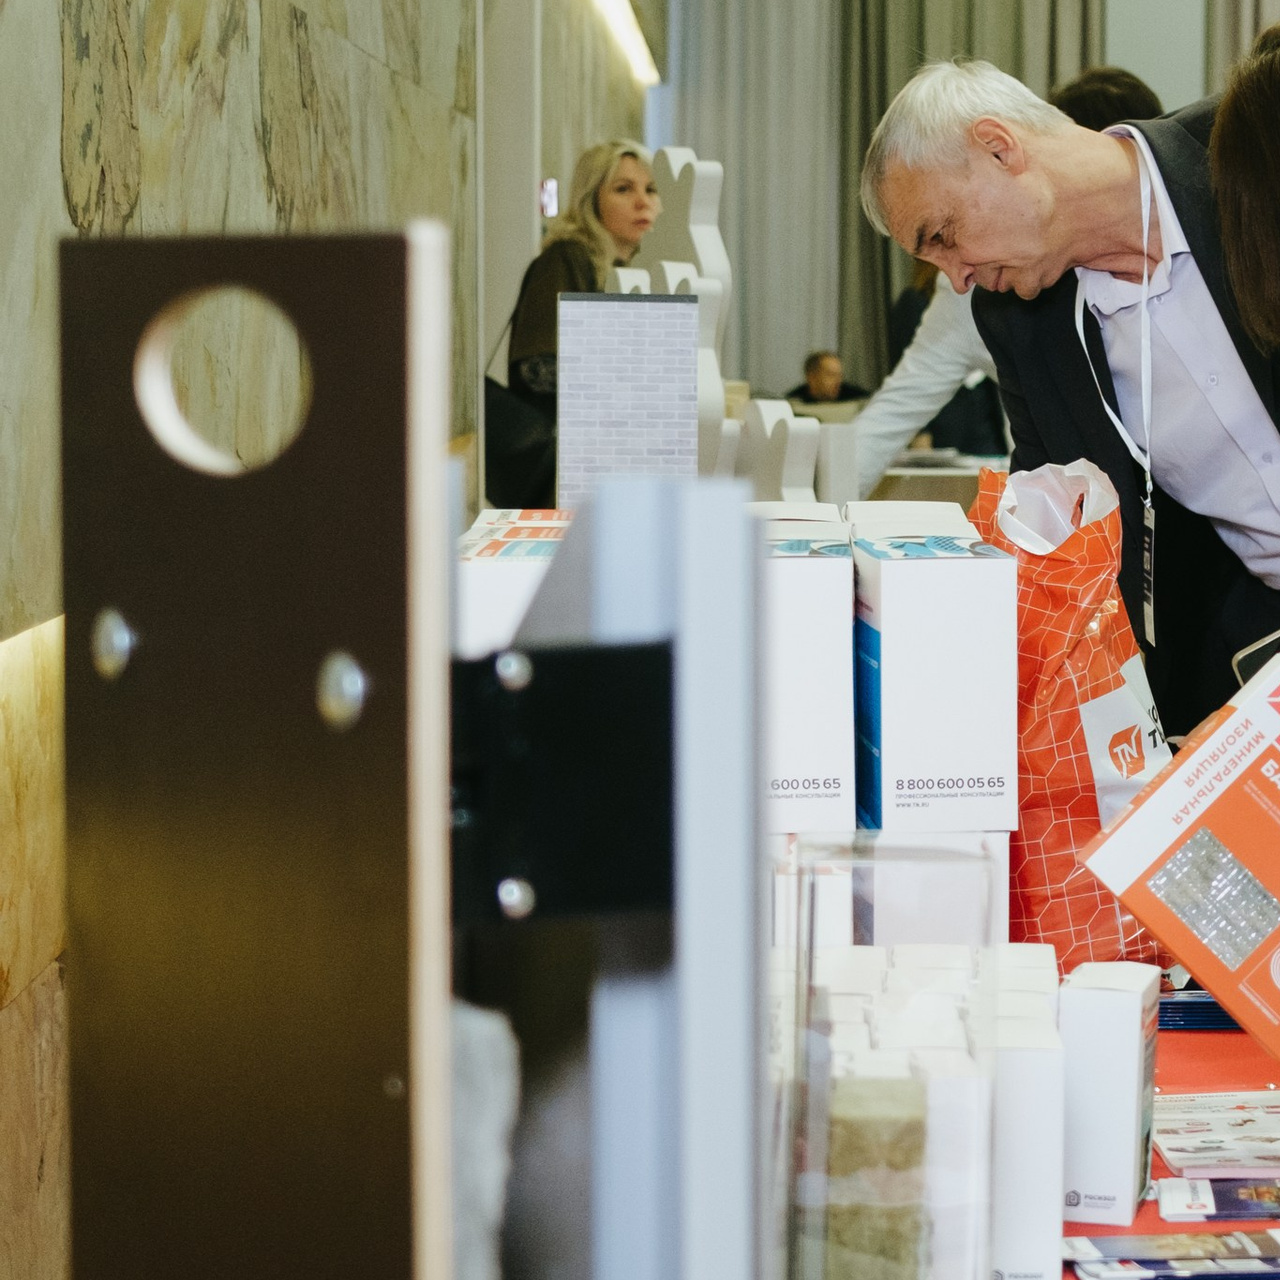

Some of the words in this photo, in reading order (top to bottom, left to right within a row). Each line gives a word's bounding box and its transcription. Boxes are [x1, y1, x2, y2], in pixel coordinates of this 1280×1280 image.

[1184, 718, 1253, 788] ИЗОЛЯЦИЯ
[771, 779, 799, 790] 600
[802, 778, 820, 789] 05
[823, 778, 841, 789] 65
[896, 779, 905, 790] 8
[907, 778, 935, 790] 800
[937, 778, 964, 789] 600
[967, 777, 985, 788] 05
[987, 776, 1005, 788] 65
[1171, 731, 1266, 825] МИНЕРАЛЬНАЯ
